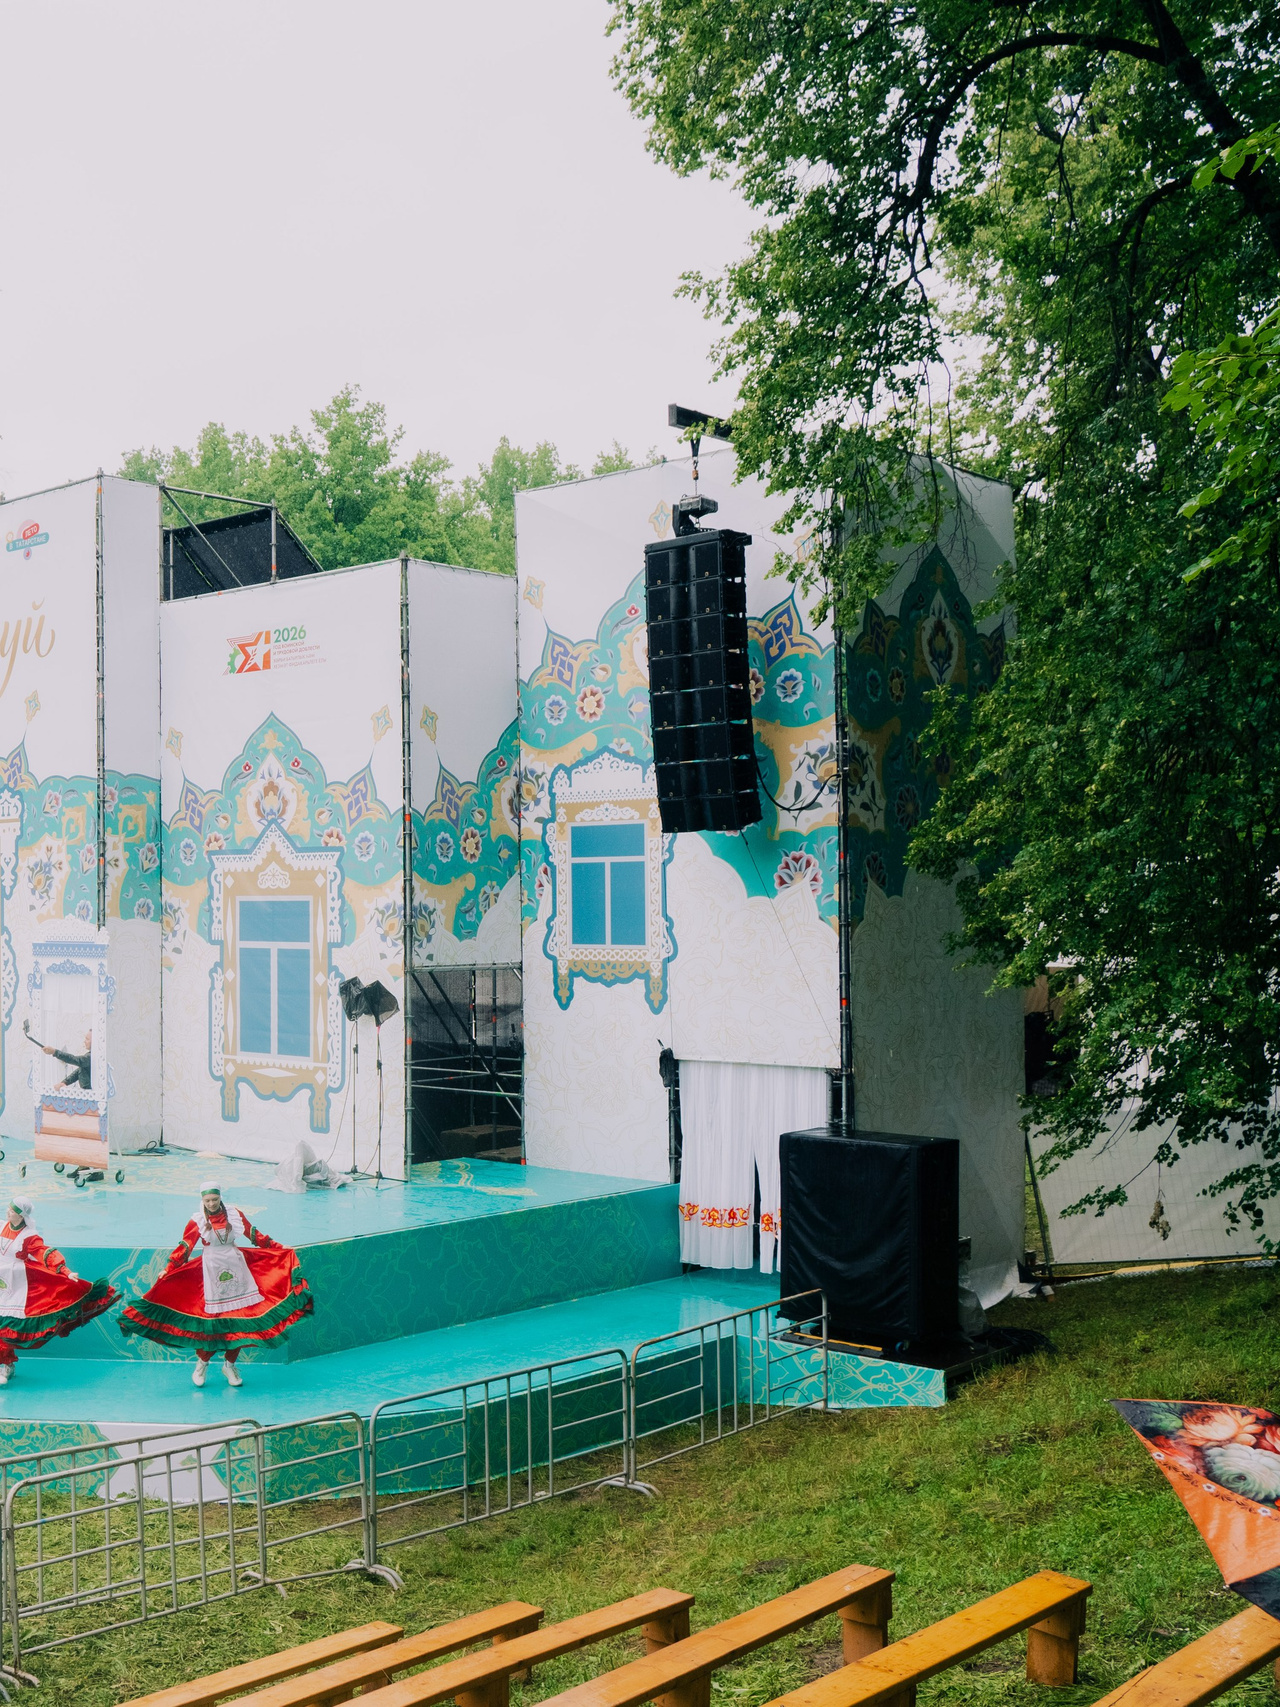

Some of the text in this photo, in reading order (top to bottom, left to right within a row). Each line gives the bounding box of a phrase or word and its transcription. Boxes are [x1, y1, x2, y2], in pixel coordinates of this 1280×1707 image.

[25, 525, 37, 538] ЛЕТО
[15, 534, 47, 548] ТАТАРСТАНЕ
[273, 625, 307, 643] 2026
